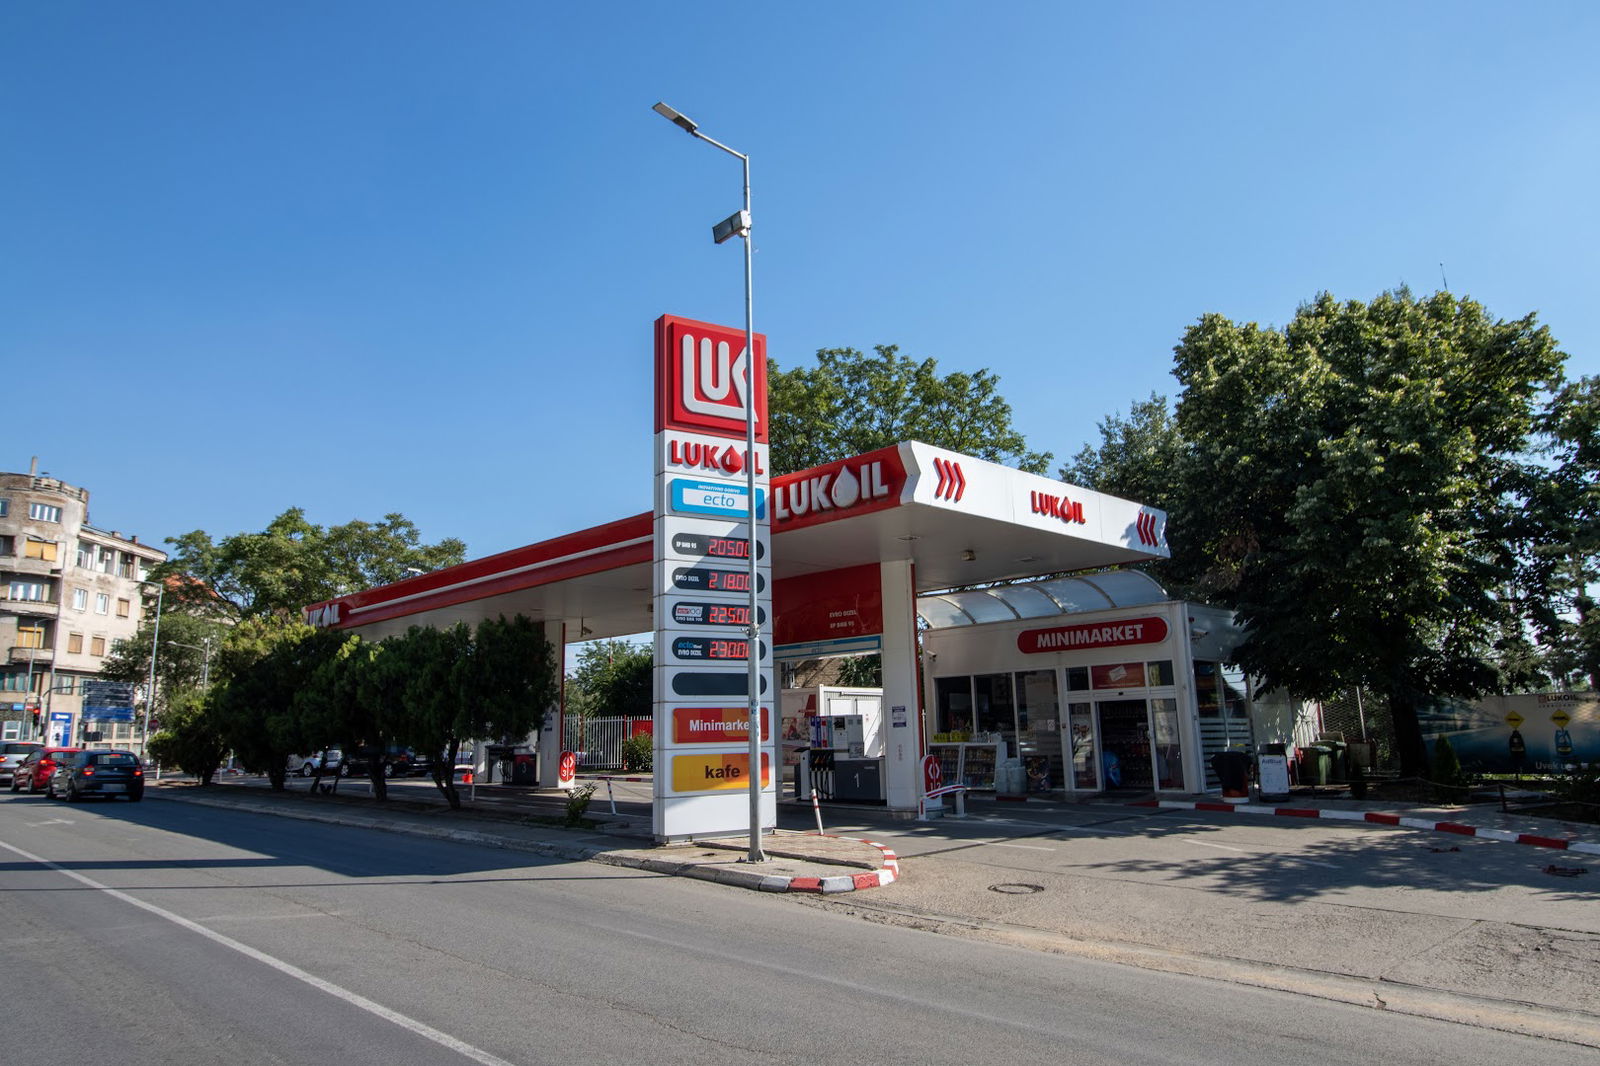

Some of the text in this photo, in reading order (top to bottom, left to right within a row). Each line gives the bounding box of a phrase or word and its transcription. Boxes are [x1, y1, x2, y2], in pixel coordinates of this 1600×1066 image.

[671, 439, 764, 475] LUKOIL
[703, 494, 735, 507] ecto
[774, 461, 889, 520] LUKOIL
[1030, 490, 1086, 525] LUKOIL
[1037, 623, 1144, 649] MINIMARKET
[689, 719, 750, 732] Minimarke
[704, 764, 741, 779] kafe
